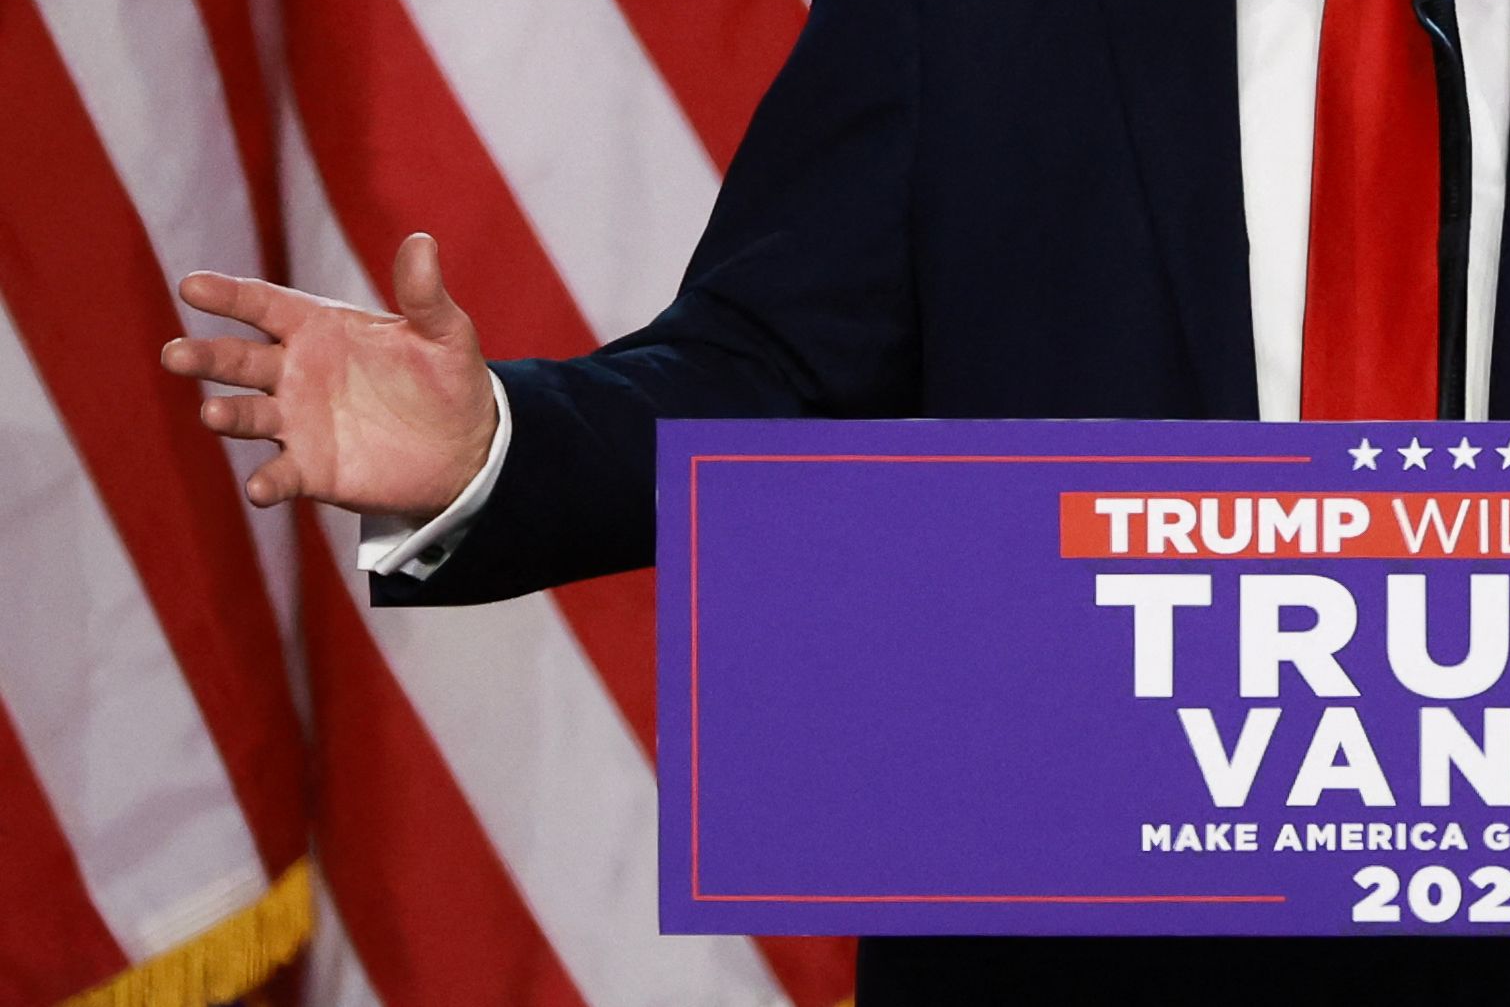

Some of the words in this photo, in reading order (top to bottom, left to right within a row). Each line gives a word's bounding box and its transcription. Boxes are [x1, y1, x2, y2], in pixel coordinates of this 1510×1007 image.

[1095, 497, 1371, 554] TRUMP
[1141, 823, 1259, 852] MAKE
[1273, 822, 1468, 852] AMERICA
